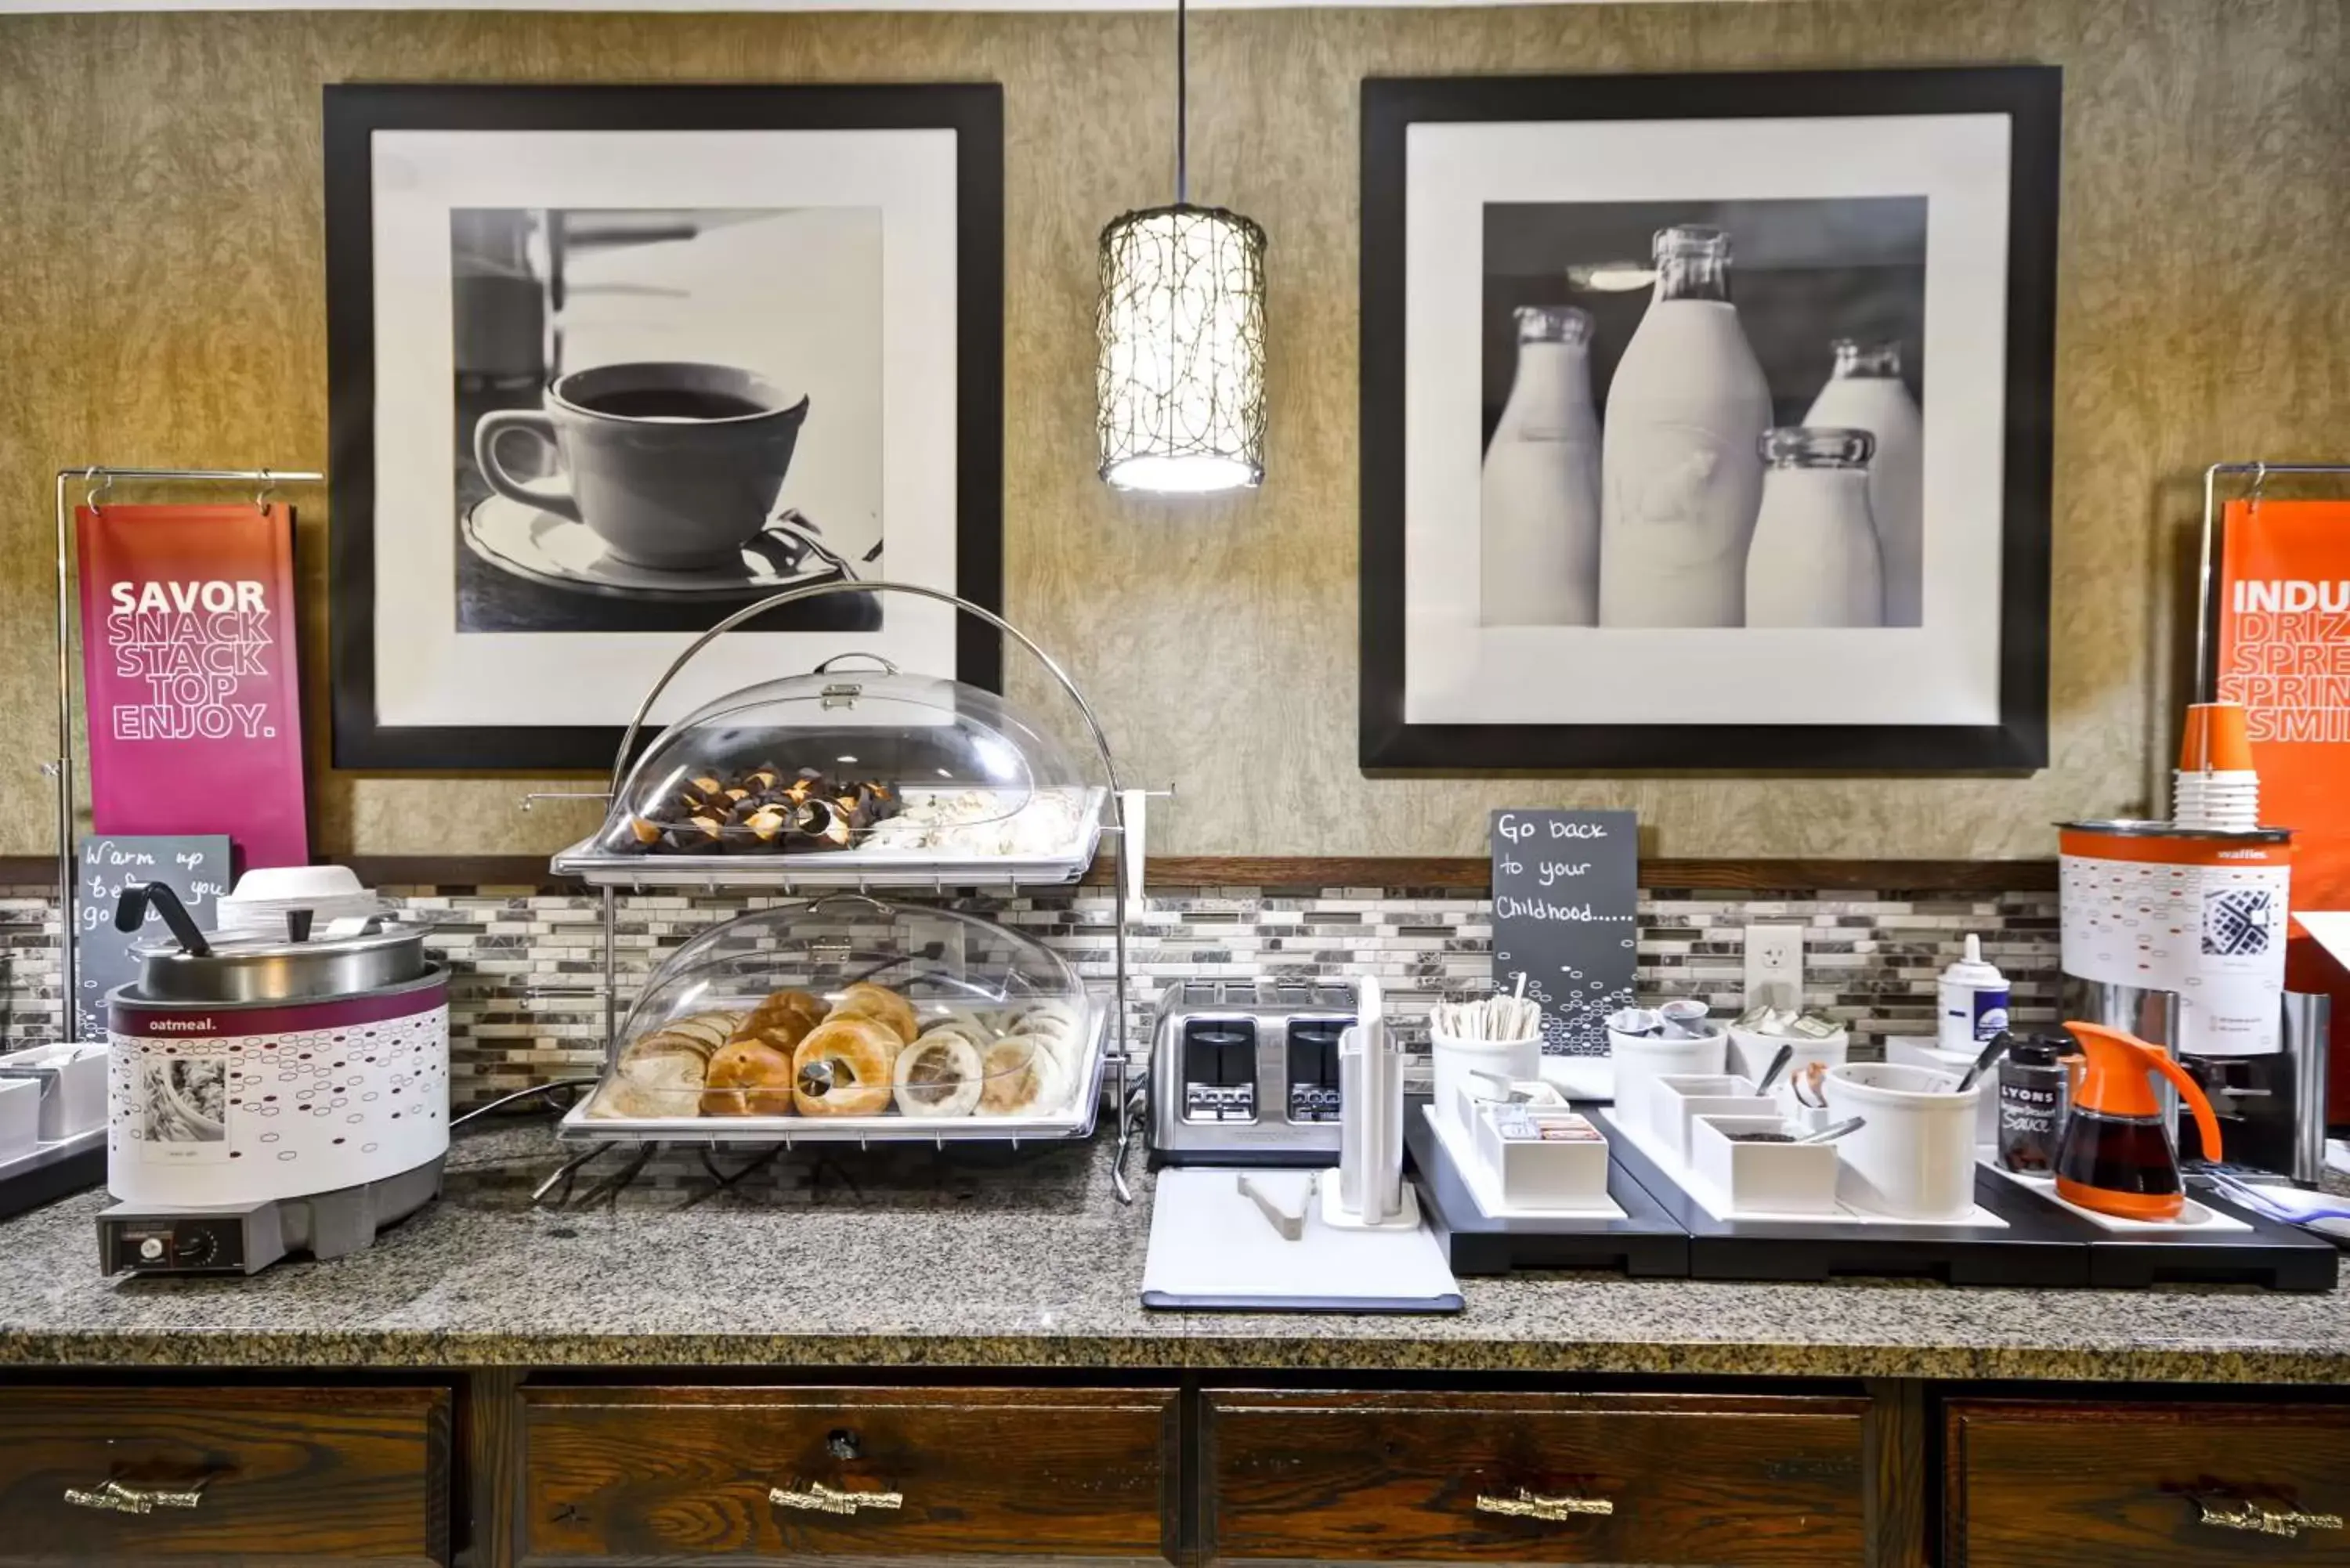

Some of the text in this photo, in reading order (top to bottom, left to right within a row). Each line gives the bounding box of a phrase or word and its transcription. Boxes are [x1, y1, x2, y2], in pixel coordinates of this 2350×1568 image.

[110, 581, 265, 613] SAVOR
[108, 610, 273, 645] SNACK
[117, 641, 269, 677] STACK
[146, 674, 238, 708] TOP
[113, 704, 276, 739] ENJOY.
[2246, 707, 2350, 742] SMI
[1498, 814, 1607, 844] Go back
[85, 840, 204, 870] Warm up
[1499, 853, 1592, 886] to your
[186, 879, 226, 905] you
[83, 906, 110, 930] go
[150, 1018, 217, 1031] oatmeal.
[2001, 1086, 2054, 1104] LYONS
